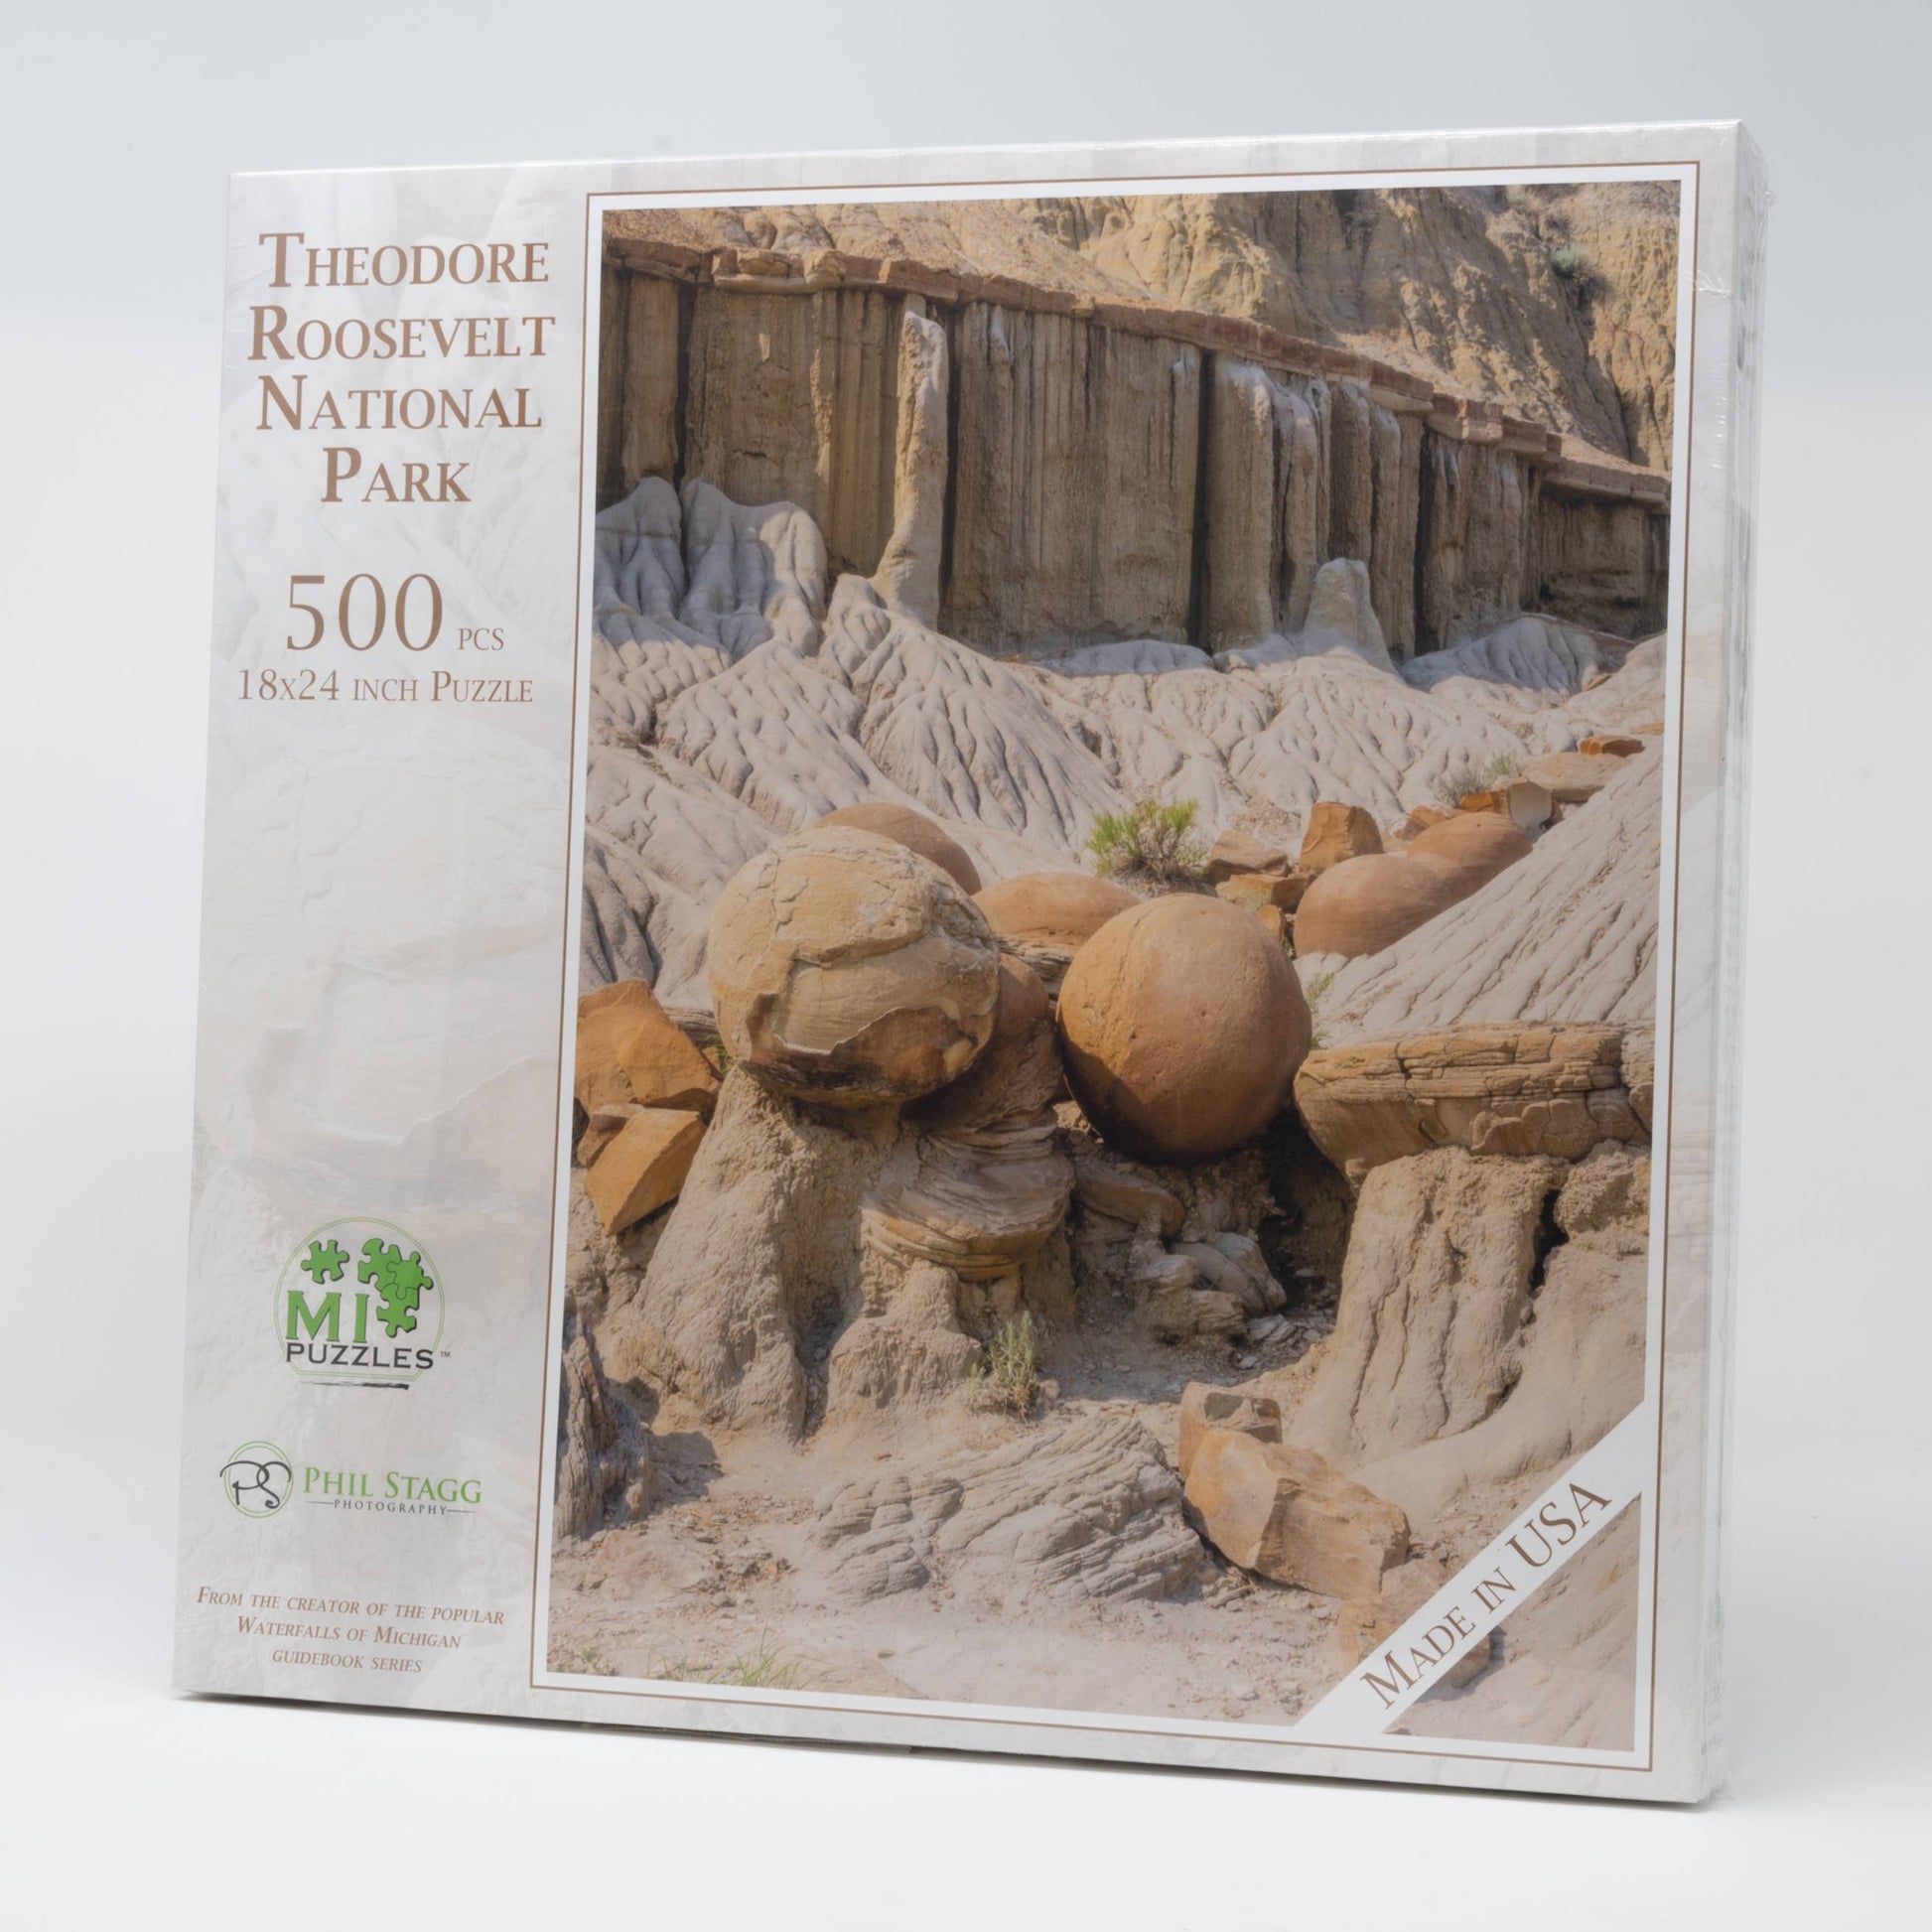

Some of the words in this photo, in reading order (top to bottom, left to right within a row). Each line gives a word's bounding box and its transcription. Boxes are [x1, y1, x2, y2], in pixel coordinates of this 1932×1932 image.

[258, 232, 549, 288] THEODORE
[247, 304, 556, 360] ROOSEVELT
[255, 374, 542, 431] NATIONAL
[320, 447, 472, 502] PARK
[286, 573, 444, 651] 500
[458, 627, 505, 651] PCS
[351, 678, 419, 703] INCH
[430, 671, 533, 703] PUZZLE
[285, 1290, 369, 1344] MI
[285, 1342, 434, 1370] PUZZLES
[303, 1466, 374, 1497] PHIL
[384, 1471, 483, 1505] STAGG
[334, 1499, 449, 1516] PHOTOGRAPHY
[197, 1587, 242, 1606] FROM
[250, 1594, 282, 1608] THE
[287, 1596, 359, 1616] CREATOR
[365, 1601, 389, 1617] OF
[395, 1603, 425, 1619] THE
[431, 1606, 504, 1626] POPULAR
[1360, 1605, 1476, 1710] MADE
[1471, 1567, 1517, 1612] IN
[1505, 1482, 1613, 1569] USA
[237, 1614, 341, 1641] WATERFALLS
[346, 1627, 368, 1643] OF
[373, 1625, 461, 1649] MICHIGAN
[272, 1649, 364, 1670] GUIDEBOOK
[370, 1658, 423, 1674] SERIES
